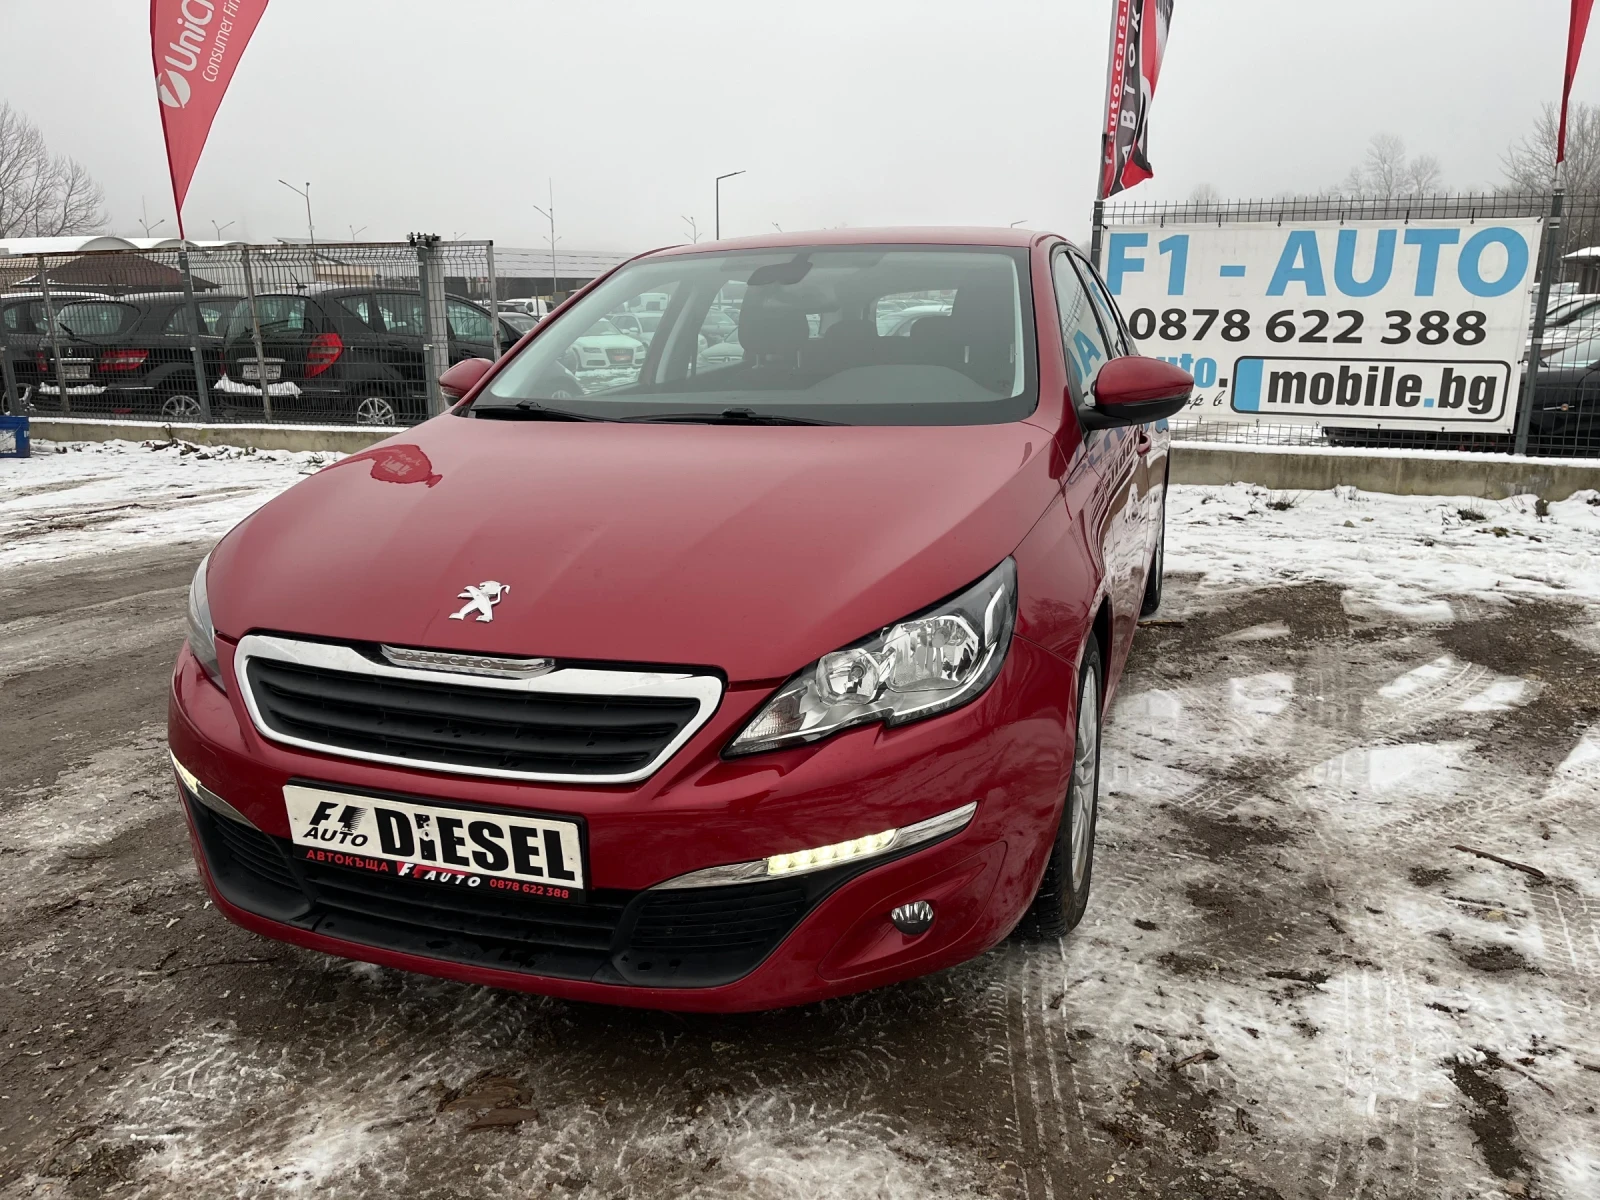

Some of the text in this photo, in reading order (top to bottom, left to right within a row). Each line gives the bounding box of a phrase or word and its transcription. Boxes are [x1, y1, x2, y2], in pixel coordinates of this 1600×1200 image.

[202, 16, 233, 82] Consumer
[1106, 231, 1190, 296] F1
[1265, 226, 1529, 298] AUTO
[1129, 308, 1487, 346] 0878 622 388
[1267, 365, 1498, 415] mobile.bg
[303, 827, 368, 847] AUTO
[306, 849, 389, 872] АВТОКЪЩА
[424, 871, 481, 887] AUTO
[489, 878, 570, 899] 0878 622 388
